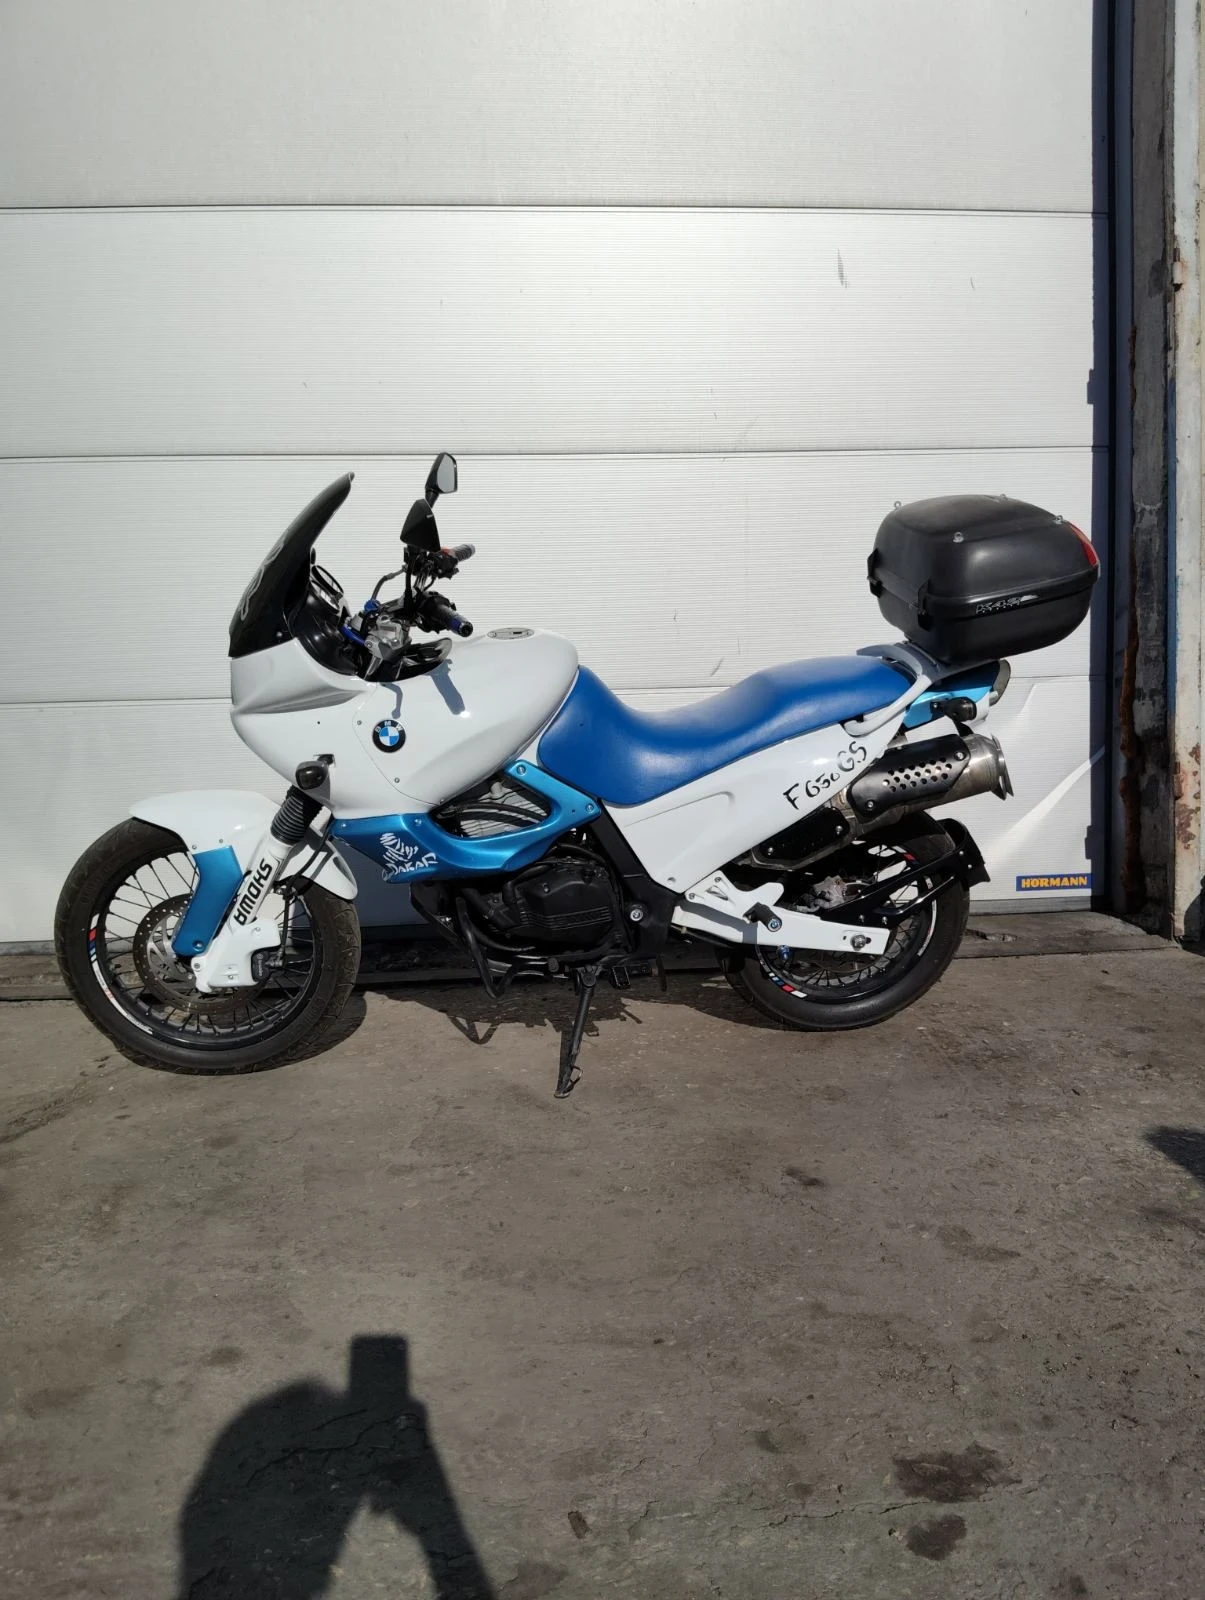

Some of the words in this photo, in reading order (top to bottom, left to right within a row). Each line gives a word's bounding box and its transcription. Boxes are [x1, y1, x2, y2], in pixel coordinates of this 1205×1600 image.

[375, 720, 403, 733] BMW
[783, 783, 799, 810] F
[233, 858, 273, 926] SHOWA
